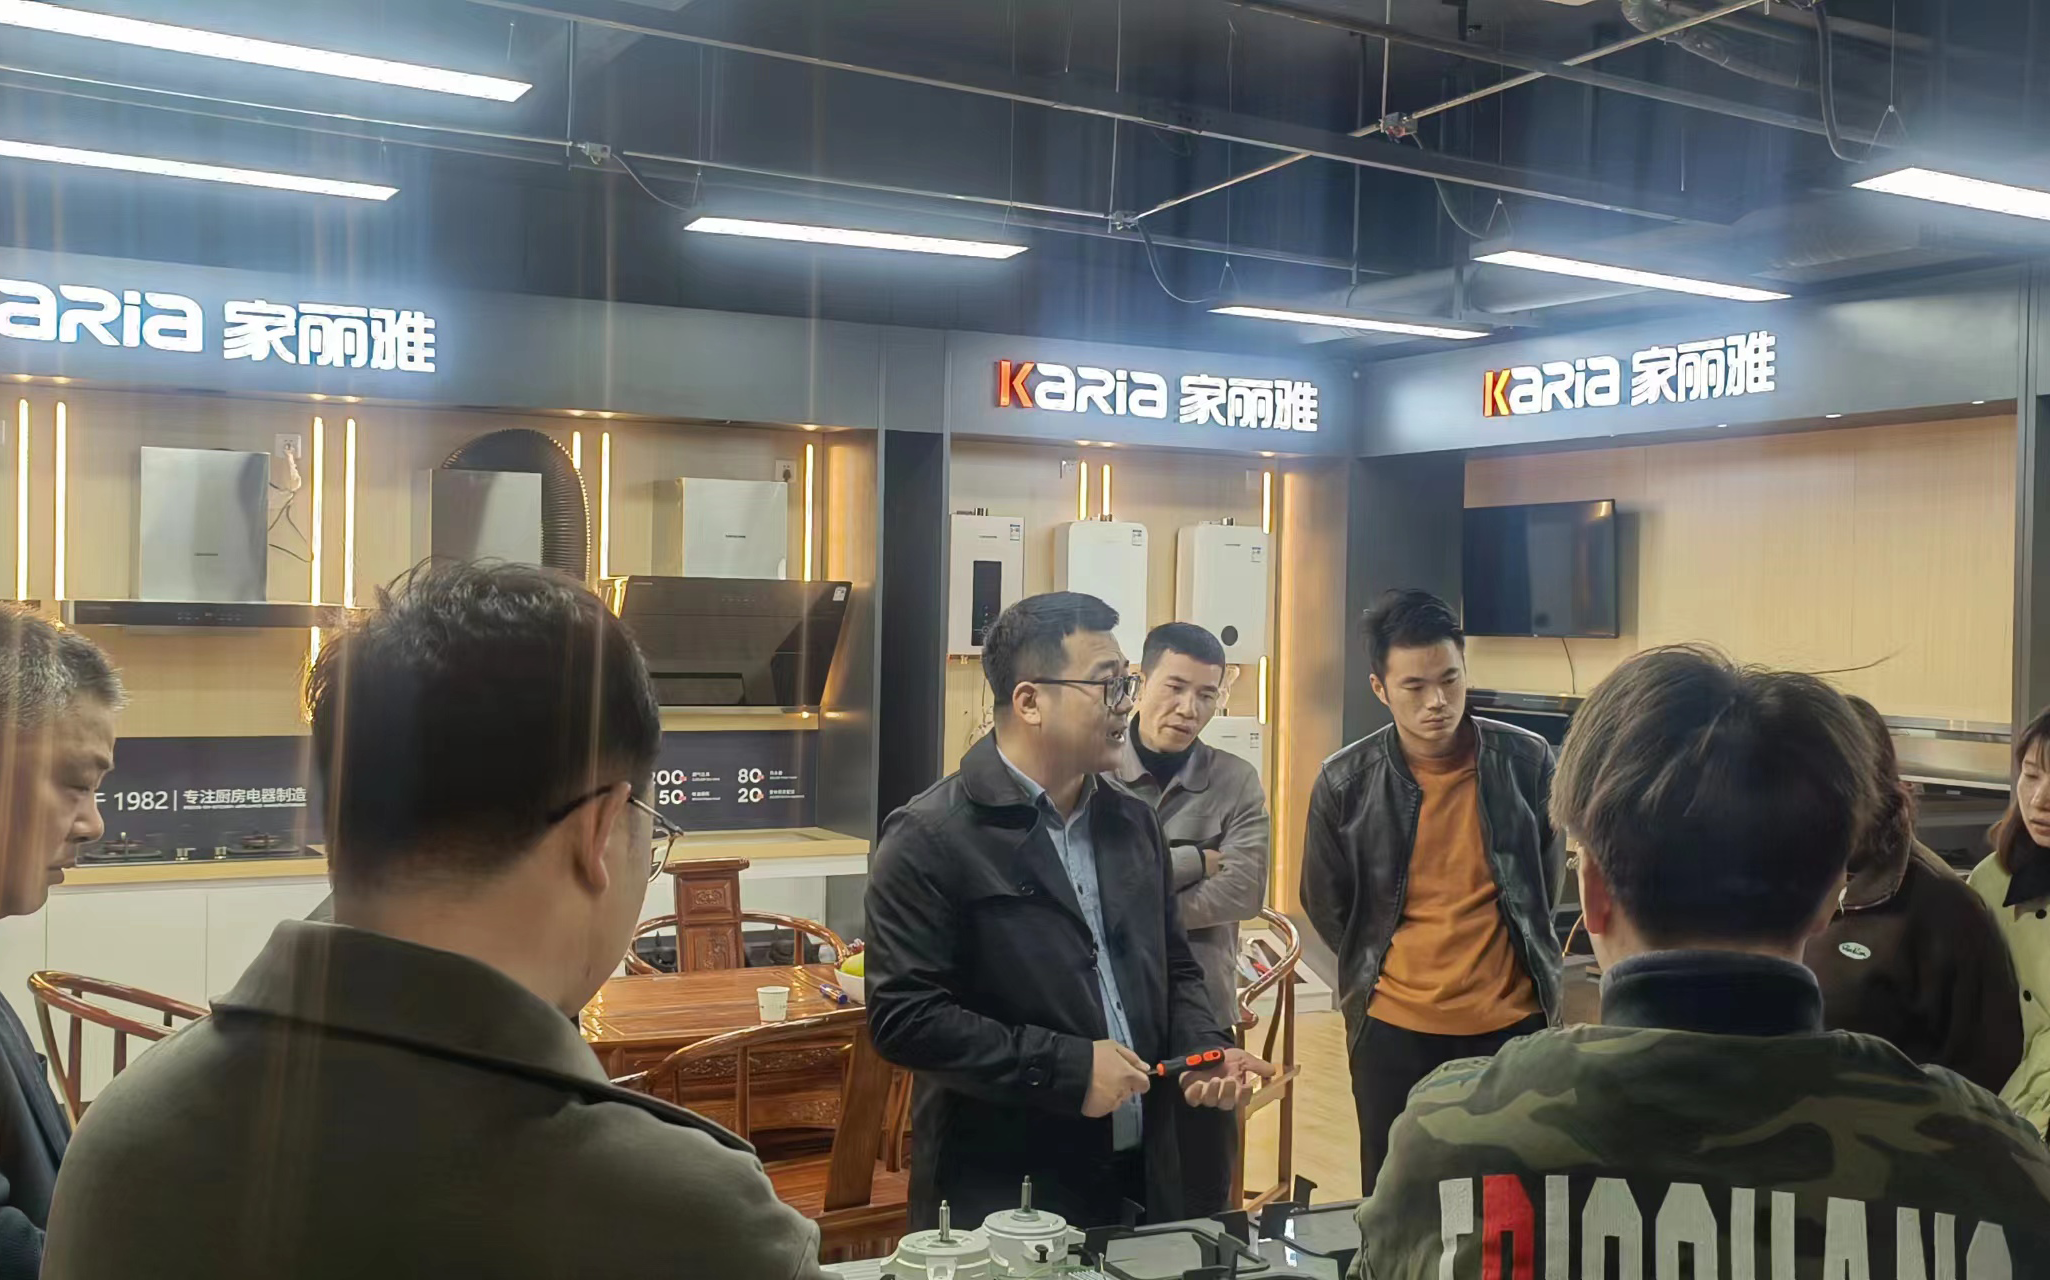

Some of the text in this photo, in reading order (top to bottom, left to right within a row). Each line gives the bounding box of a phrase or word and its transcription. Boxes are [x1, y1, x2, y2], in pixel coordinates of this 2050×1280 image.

[222, 299, 436, 373] 家丽雅
[1630, 330, 1775, 407] 家丽雅
[1179, 374, 1318, 432] 家丽雅
[737, 768, 763, 784] 80
[113, 790, 169, 811] 1982
[183, 787, 307, 804] 专注厨房电器制造
[658, 789, 685, 805] 50
[737, 787, 763, 803] 20
